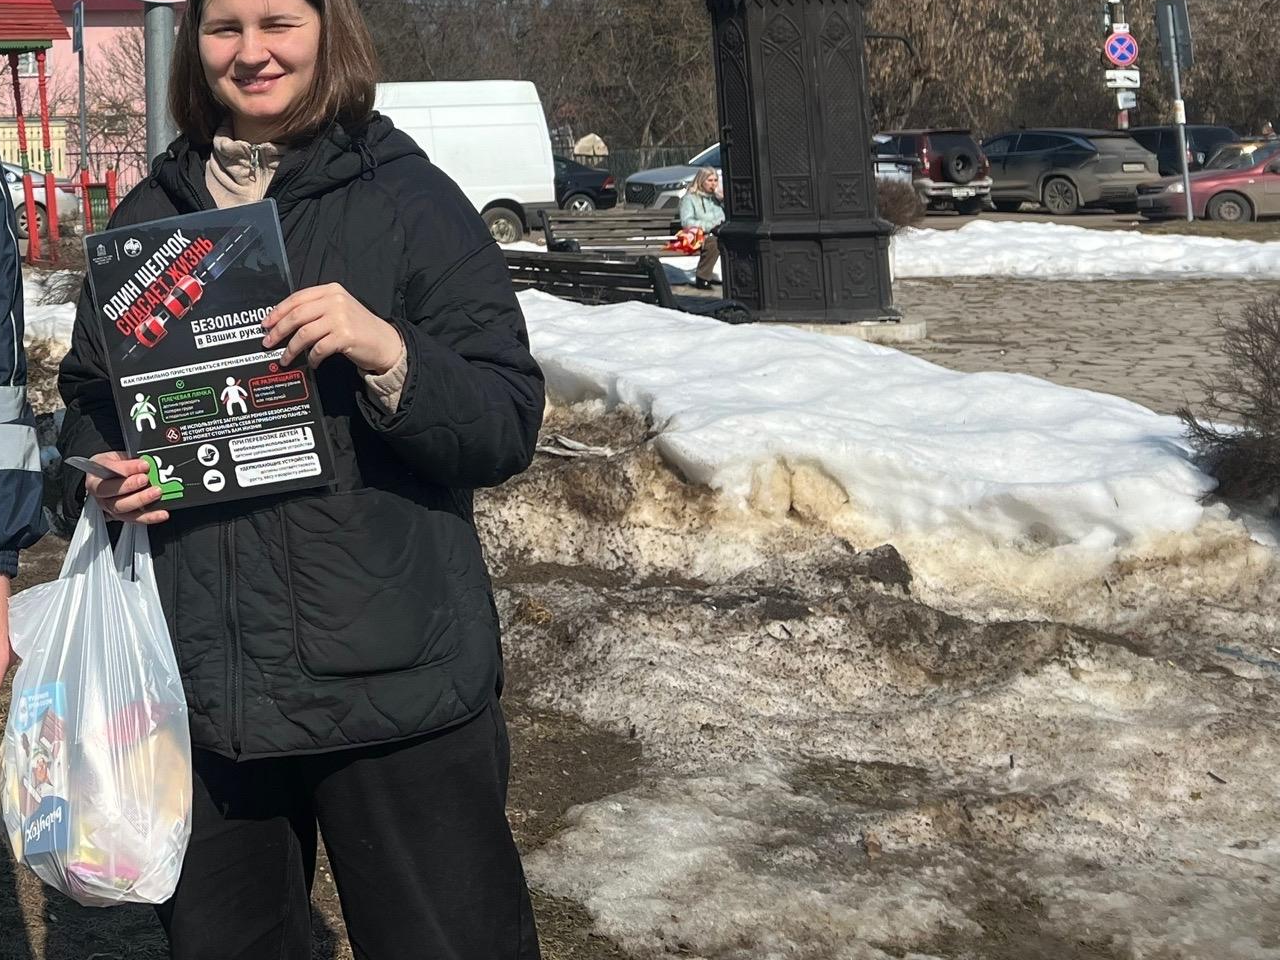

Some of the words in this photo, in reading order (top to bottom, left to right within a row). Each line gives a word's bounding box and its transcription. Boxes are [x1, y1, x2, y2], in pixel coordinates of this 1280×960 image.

[103, 279, 141, 320] ОДИН
[135, 229, 191, 288] ЩЕЛЧОК
[116, 276, 172, 336] СПАСАЕТ
[165, 237, 215, 283] ЖИЗНЬ
[205, 331, 237, 344] Ваших
[135, 371, 169, 381] ПРАВИЛЬНО
[169, 362, 220, 375] ПРИСТЕГИВАТЬСЯ
[221, 358, 244, 366] РЕМНЕМ
[244, 432, 277, 444] ПЕРЕВОЗКЕ
[278, 428, 298, 438] ДЕТЕЙ
[25, 806, 62, 842] babyfox
